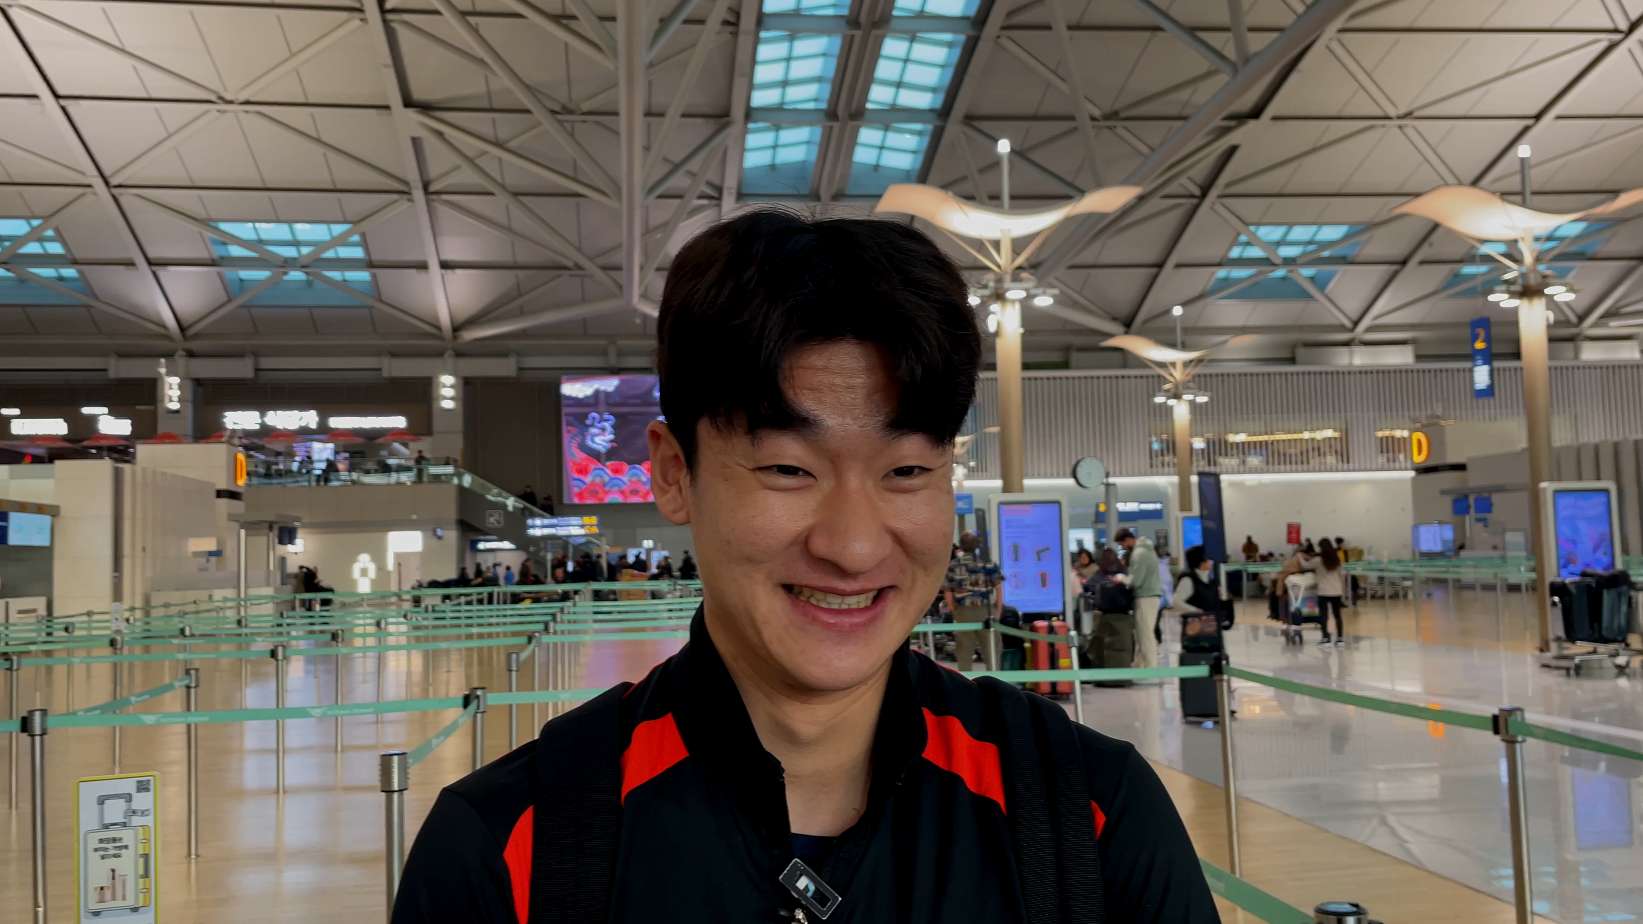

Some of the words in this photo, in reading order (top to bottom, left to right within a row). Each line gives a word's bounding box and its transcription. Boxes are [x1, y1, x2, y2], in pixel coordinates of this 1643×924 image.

[1473, 327, 1487, 350] 2
[1411, 431, 1428, 464] D
[235, 451, 247, 486] D
